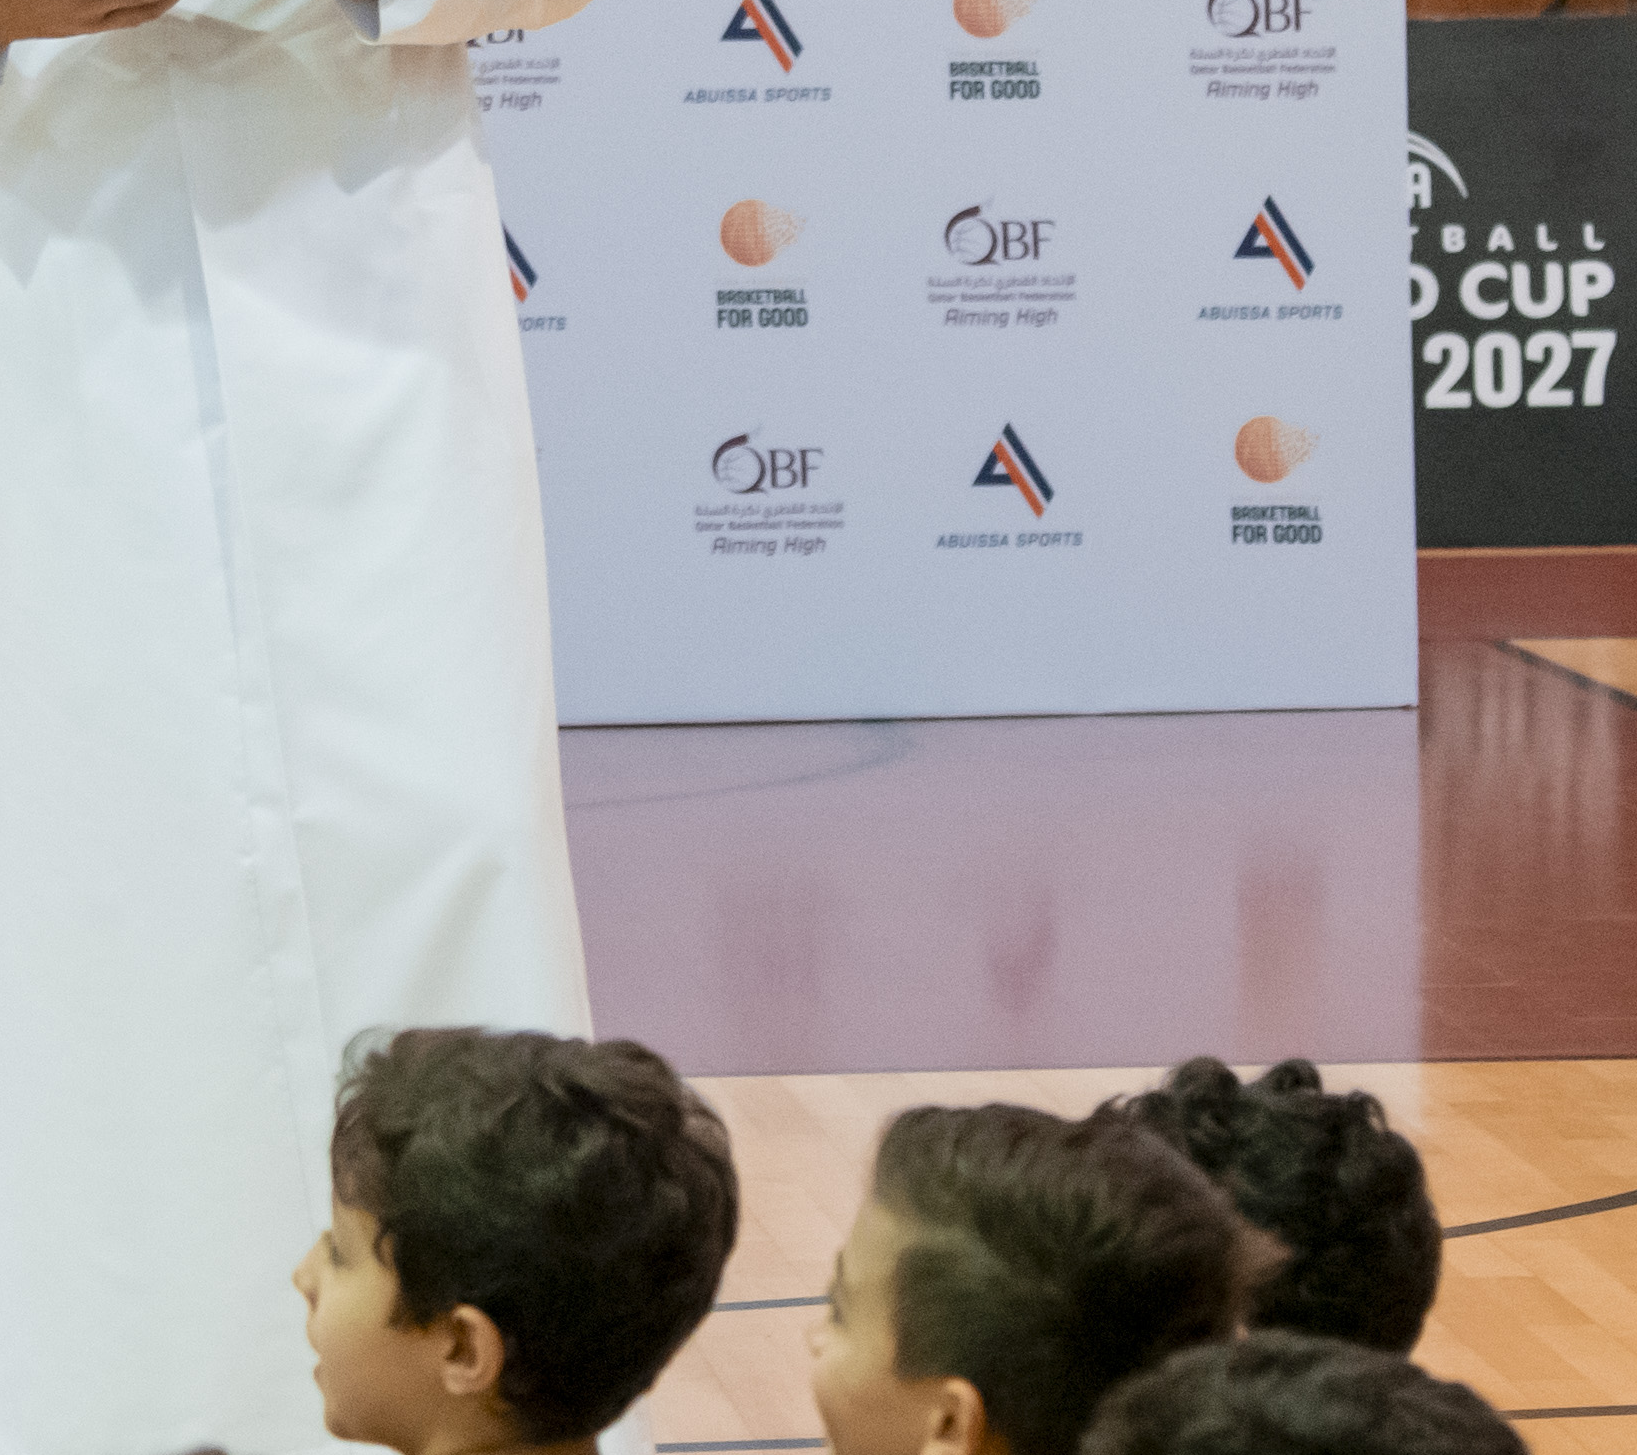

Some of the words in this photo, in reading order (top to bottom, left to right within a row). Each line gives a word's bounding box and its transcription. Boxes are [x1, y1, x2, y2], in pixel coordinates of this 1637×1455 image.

[949, 62, 1039, 78] BASKETBALL
[684, 88, 757, 104] ABUISSA
[764, 87, 830, 103] SPORTS
[950, 81, 985, 100] FOR
[991, 80, 1041, 100] GOOD
[944, 205, 1056, 267] QBF
[717, 290, 807, 306] BASKETBALL
[1459, 259, 1615, 320] CUP
[718, 309, 753, 328] FOR
[759, 308, 809, 328] GOOD
[1198, 305, 1270, 321] ABUISSA
[1277, 304, 1343, 320] SPORTS
[1423, 330, 1617, 409] 2027
[712, 433, 824, 495] QBF
[1231, 506, 1321, 522] BASKETBALL
[936, 533, 1009, 549] ABUISSA
[1016, 532, 1082, 548] SPORTS
[1232, 525, 1267, 544] FOR
[1273, 524, 1323, 544] GOOD
